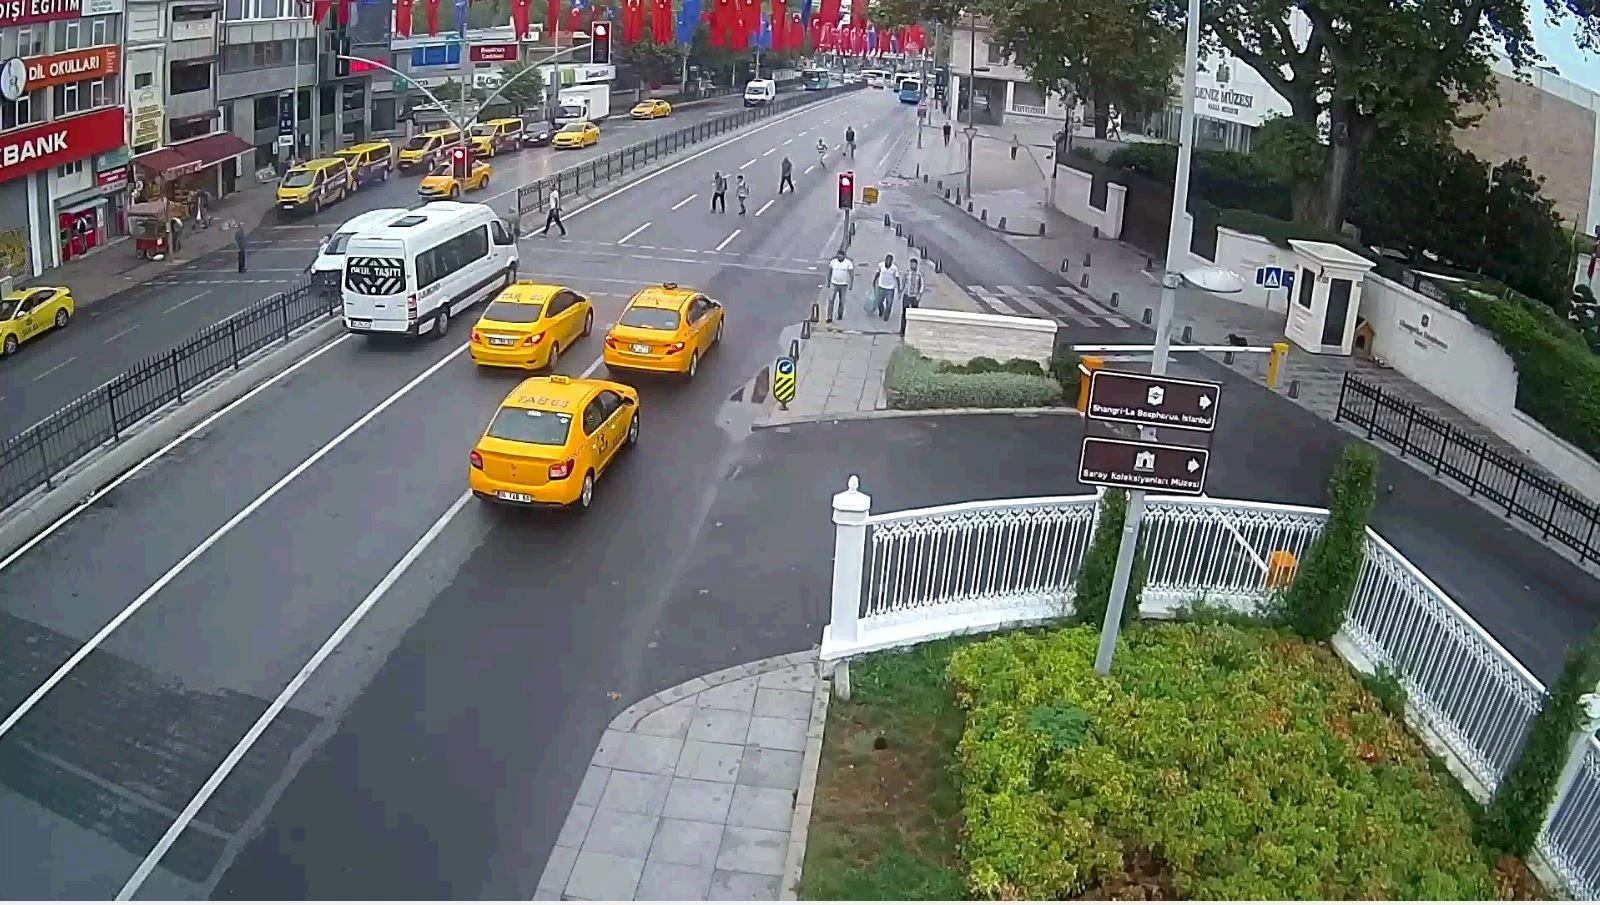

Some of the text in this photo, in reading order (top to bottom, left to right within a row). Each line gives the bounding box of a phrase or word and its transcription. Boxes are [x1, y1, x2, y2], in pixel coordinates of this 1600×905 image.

[29, 63, 45, 81] DİL
[49, 55, 100, 77] OKULLARI
[0, 130, 69, 168] BANK
[1092, 404, 1135, 416] Shangri-La
[1083, 469, 1108, 480] Saray
